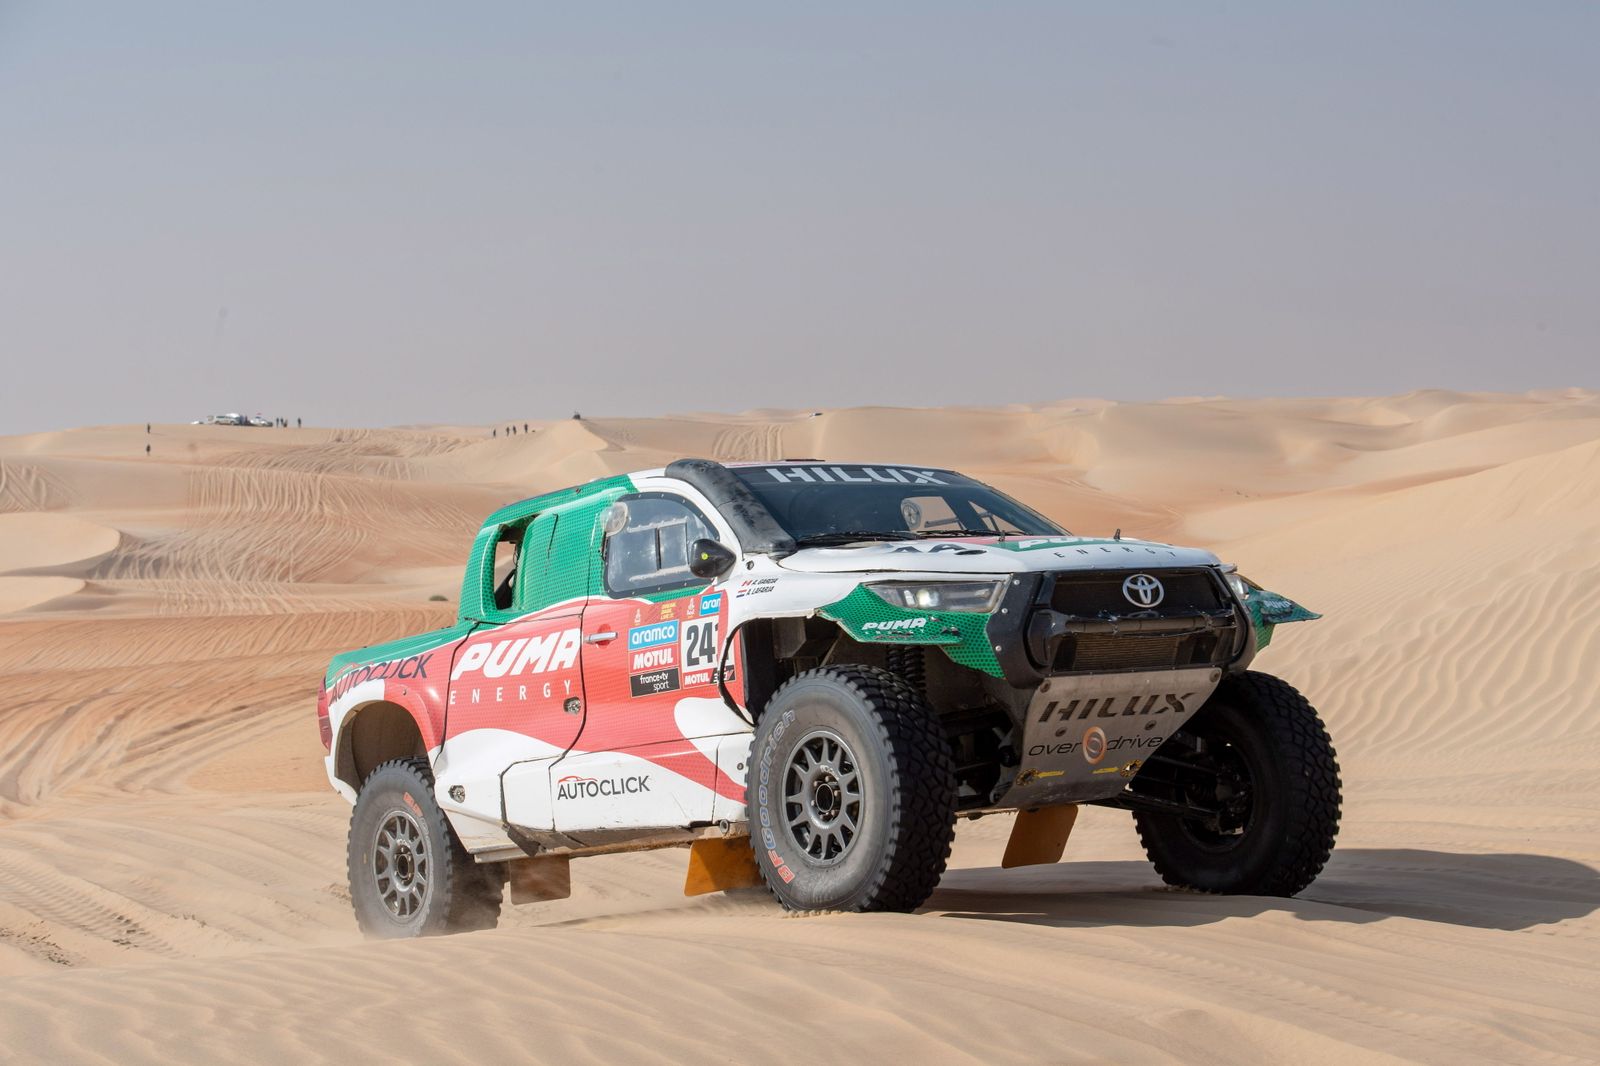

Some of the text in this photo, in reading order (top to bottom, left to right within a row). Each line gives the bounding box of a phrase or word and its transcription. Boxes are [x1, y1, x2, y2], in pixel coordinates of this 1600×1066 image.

[765, 466, 949, 485] HILUX
[632, 625, 675, 645] aramco
[861, 617, 927, 630] PUMA
[451, 628, 580, 681] PUMA
[633, 647, 674, 670] MOTUL
[329, 653, 434, 707] AUTOCLICK
[653, 681, 670, 694] sport
[684, 672, 710, 686] MOTUL
[450, 680, 572, 705] ENERGY
[1038, 692, 1196, 723] HILUX
[557, 775, 651, 800] AUTOCLICK
